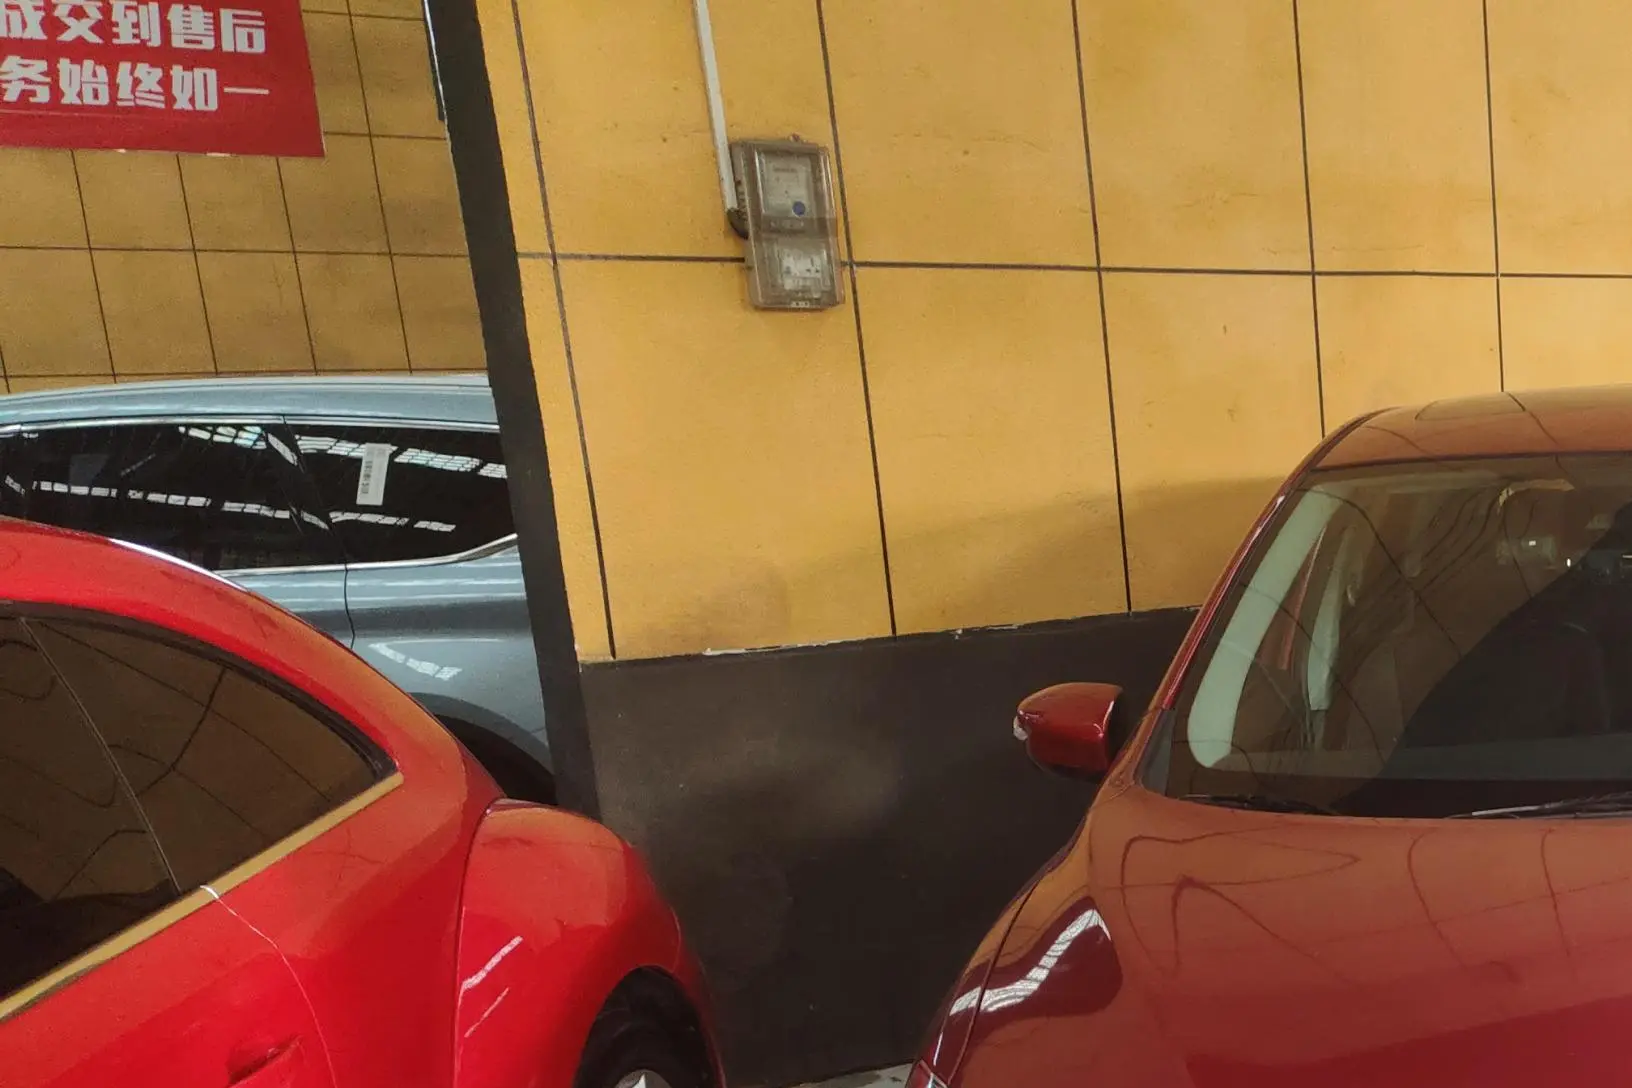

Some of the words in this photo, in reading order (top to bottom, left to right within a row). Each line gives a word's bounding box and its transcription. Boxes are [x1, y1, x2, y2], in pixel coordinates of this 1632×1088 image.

[0, 0, 265, 53] 成交到售后
[0, 55, 270, 111] 务始终如一
